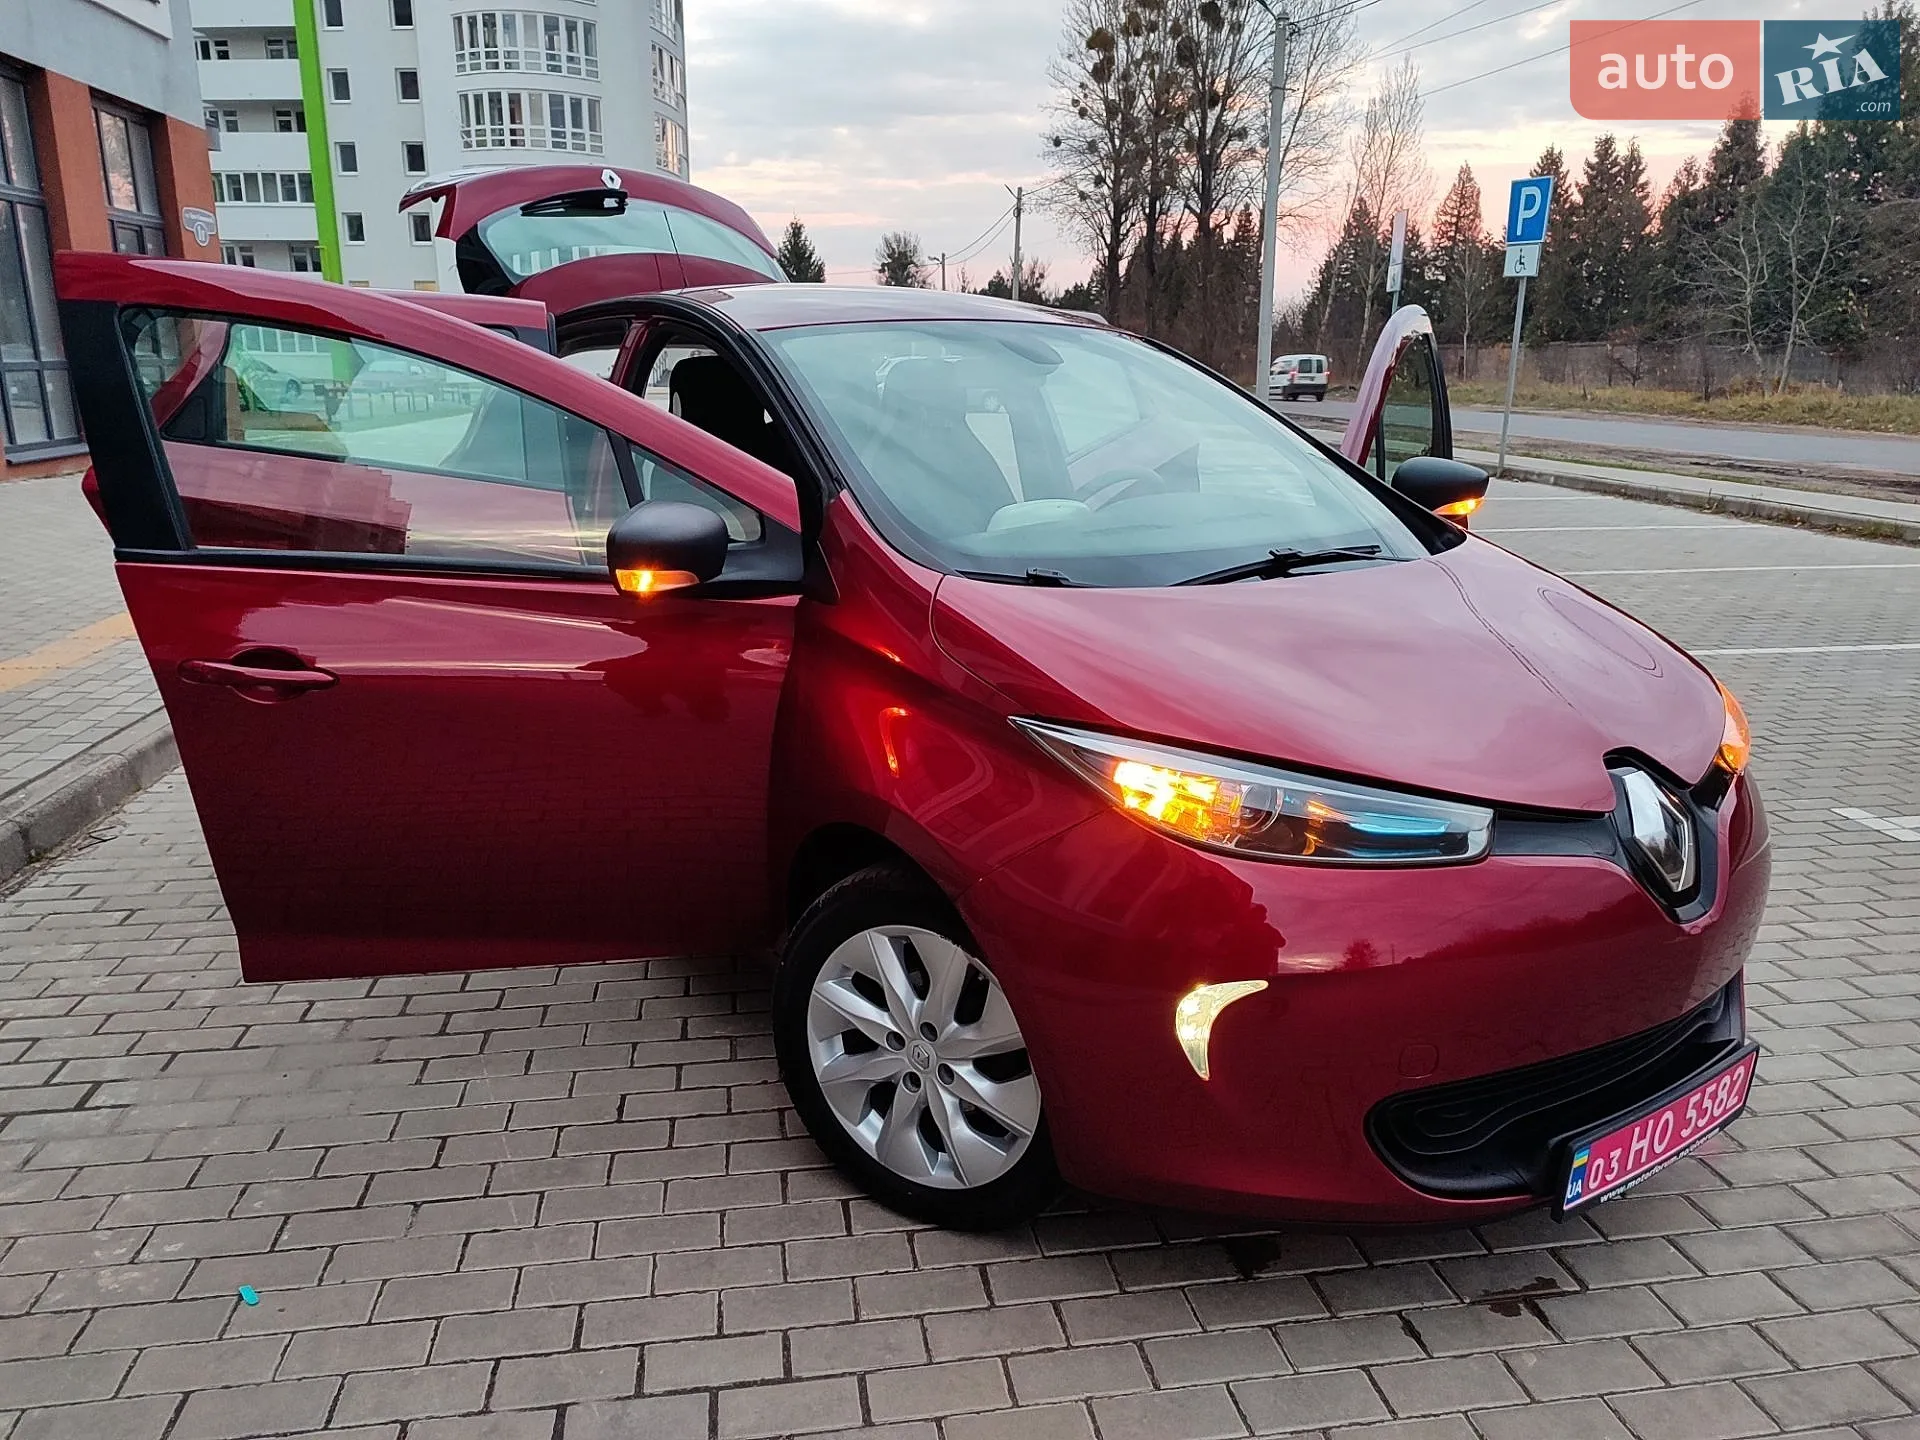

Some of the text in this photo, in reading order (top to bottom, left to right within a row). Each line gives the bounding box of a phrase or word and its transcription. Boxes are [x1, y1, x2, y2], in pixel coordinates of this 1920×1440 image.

[1516, 185, 1543, 237] P
[1567, 1065, 1745, 1199] UA 03 HO 5582
